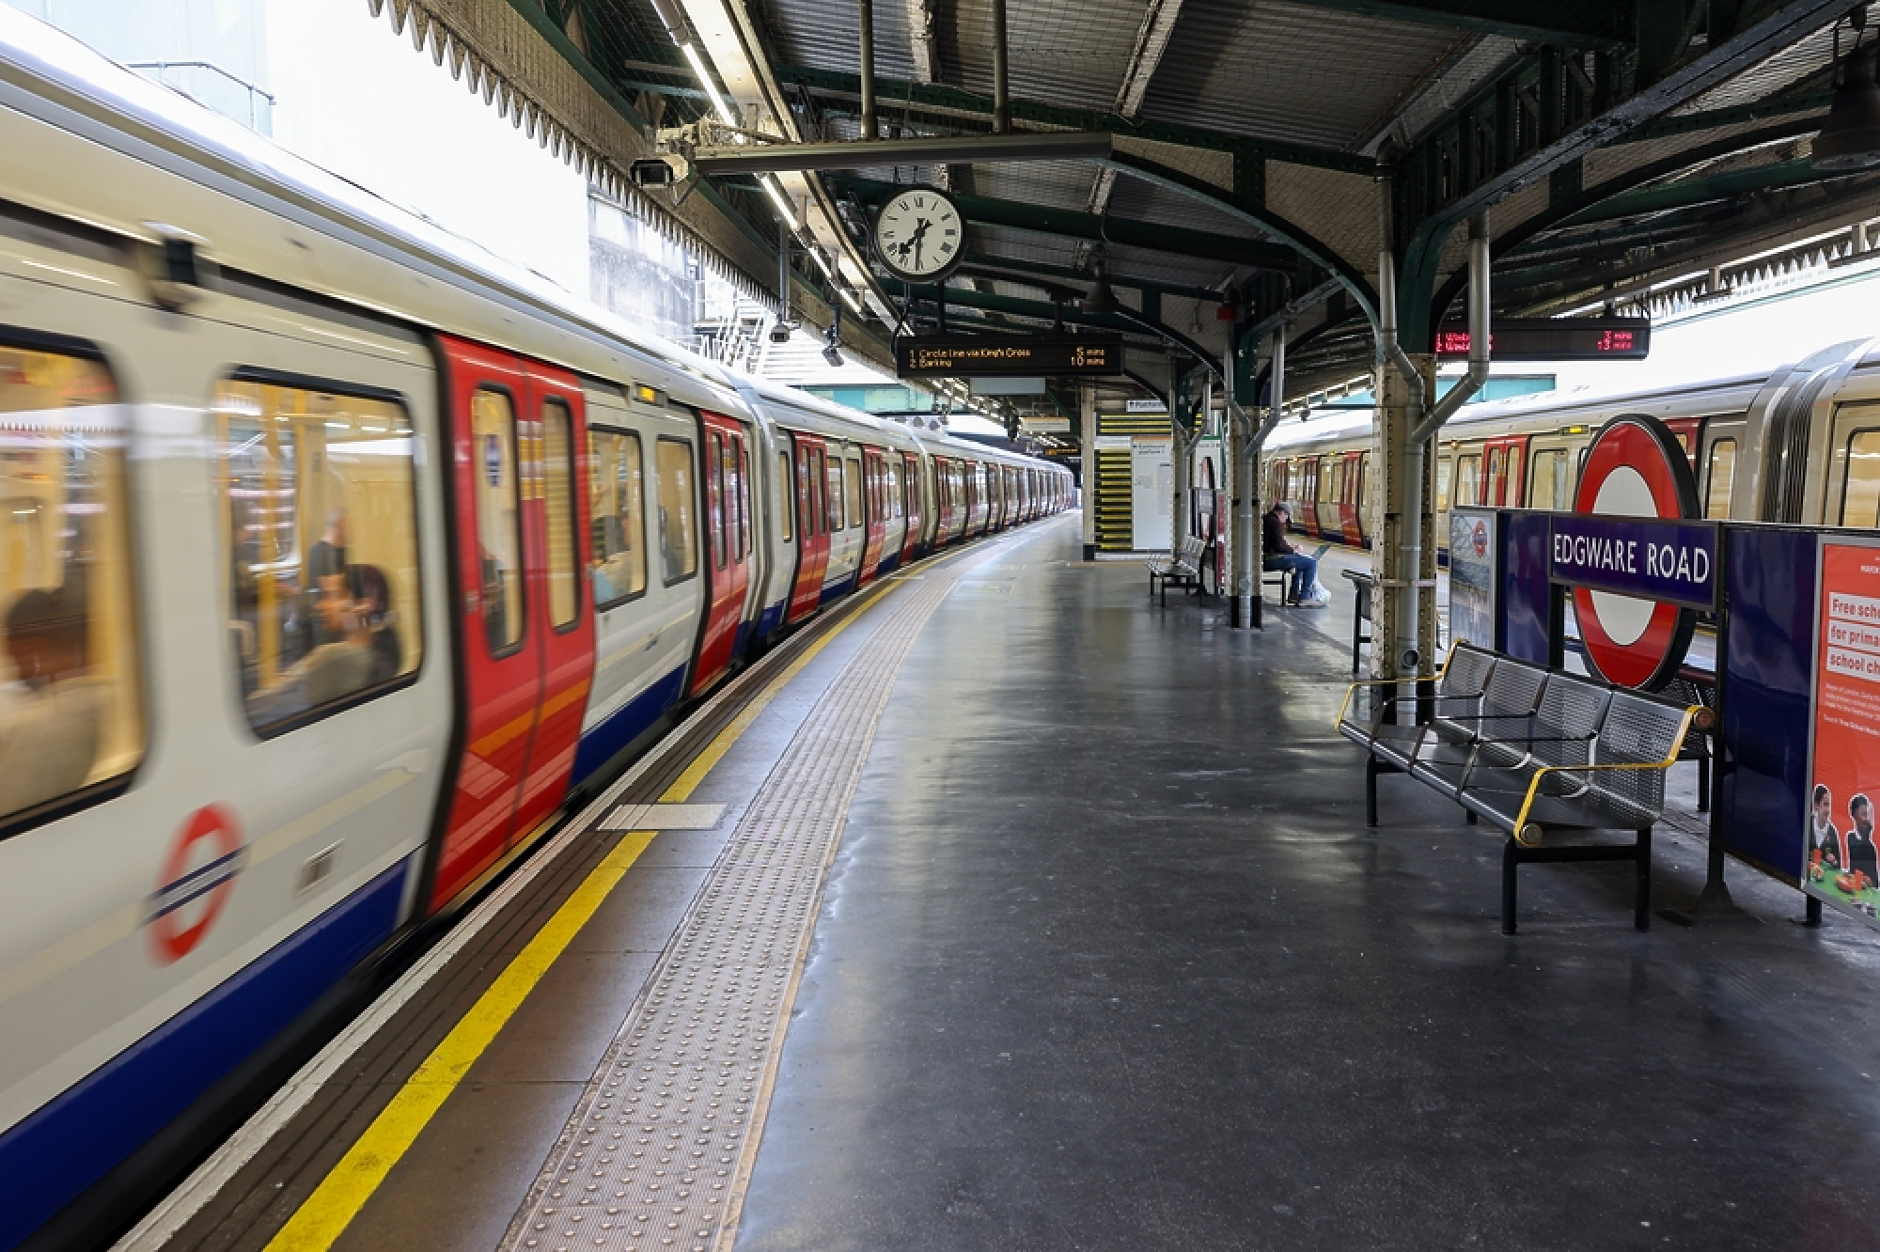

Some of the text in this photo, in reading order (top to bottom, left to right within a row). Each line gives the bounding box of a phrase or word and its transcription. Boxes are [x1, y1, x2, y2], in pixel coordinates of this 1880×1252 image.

[919, 349, 947, 358] Circle
[966, 349, 979, 358] via
[1005, 347, 1031, 358] Cross
[1086, 348, 1104, 356] mins
[909, 356, 1104, 369] 2 Barking 10 mins
[1554, 533, 1710, 584] EDGWARE ROAD
[1832, 598, 1856, 616] Free
[1830, 625, 1847, 640] for
[1830, 653, 1866, 672] school
